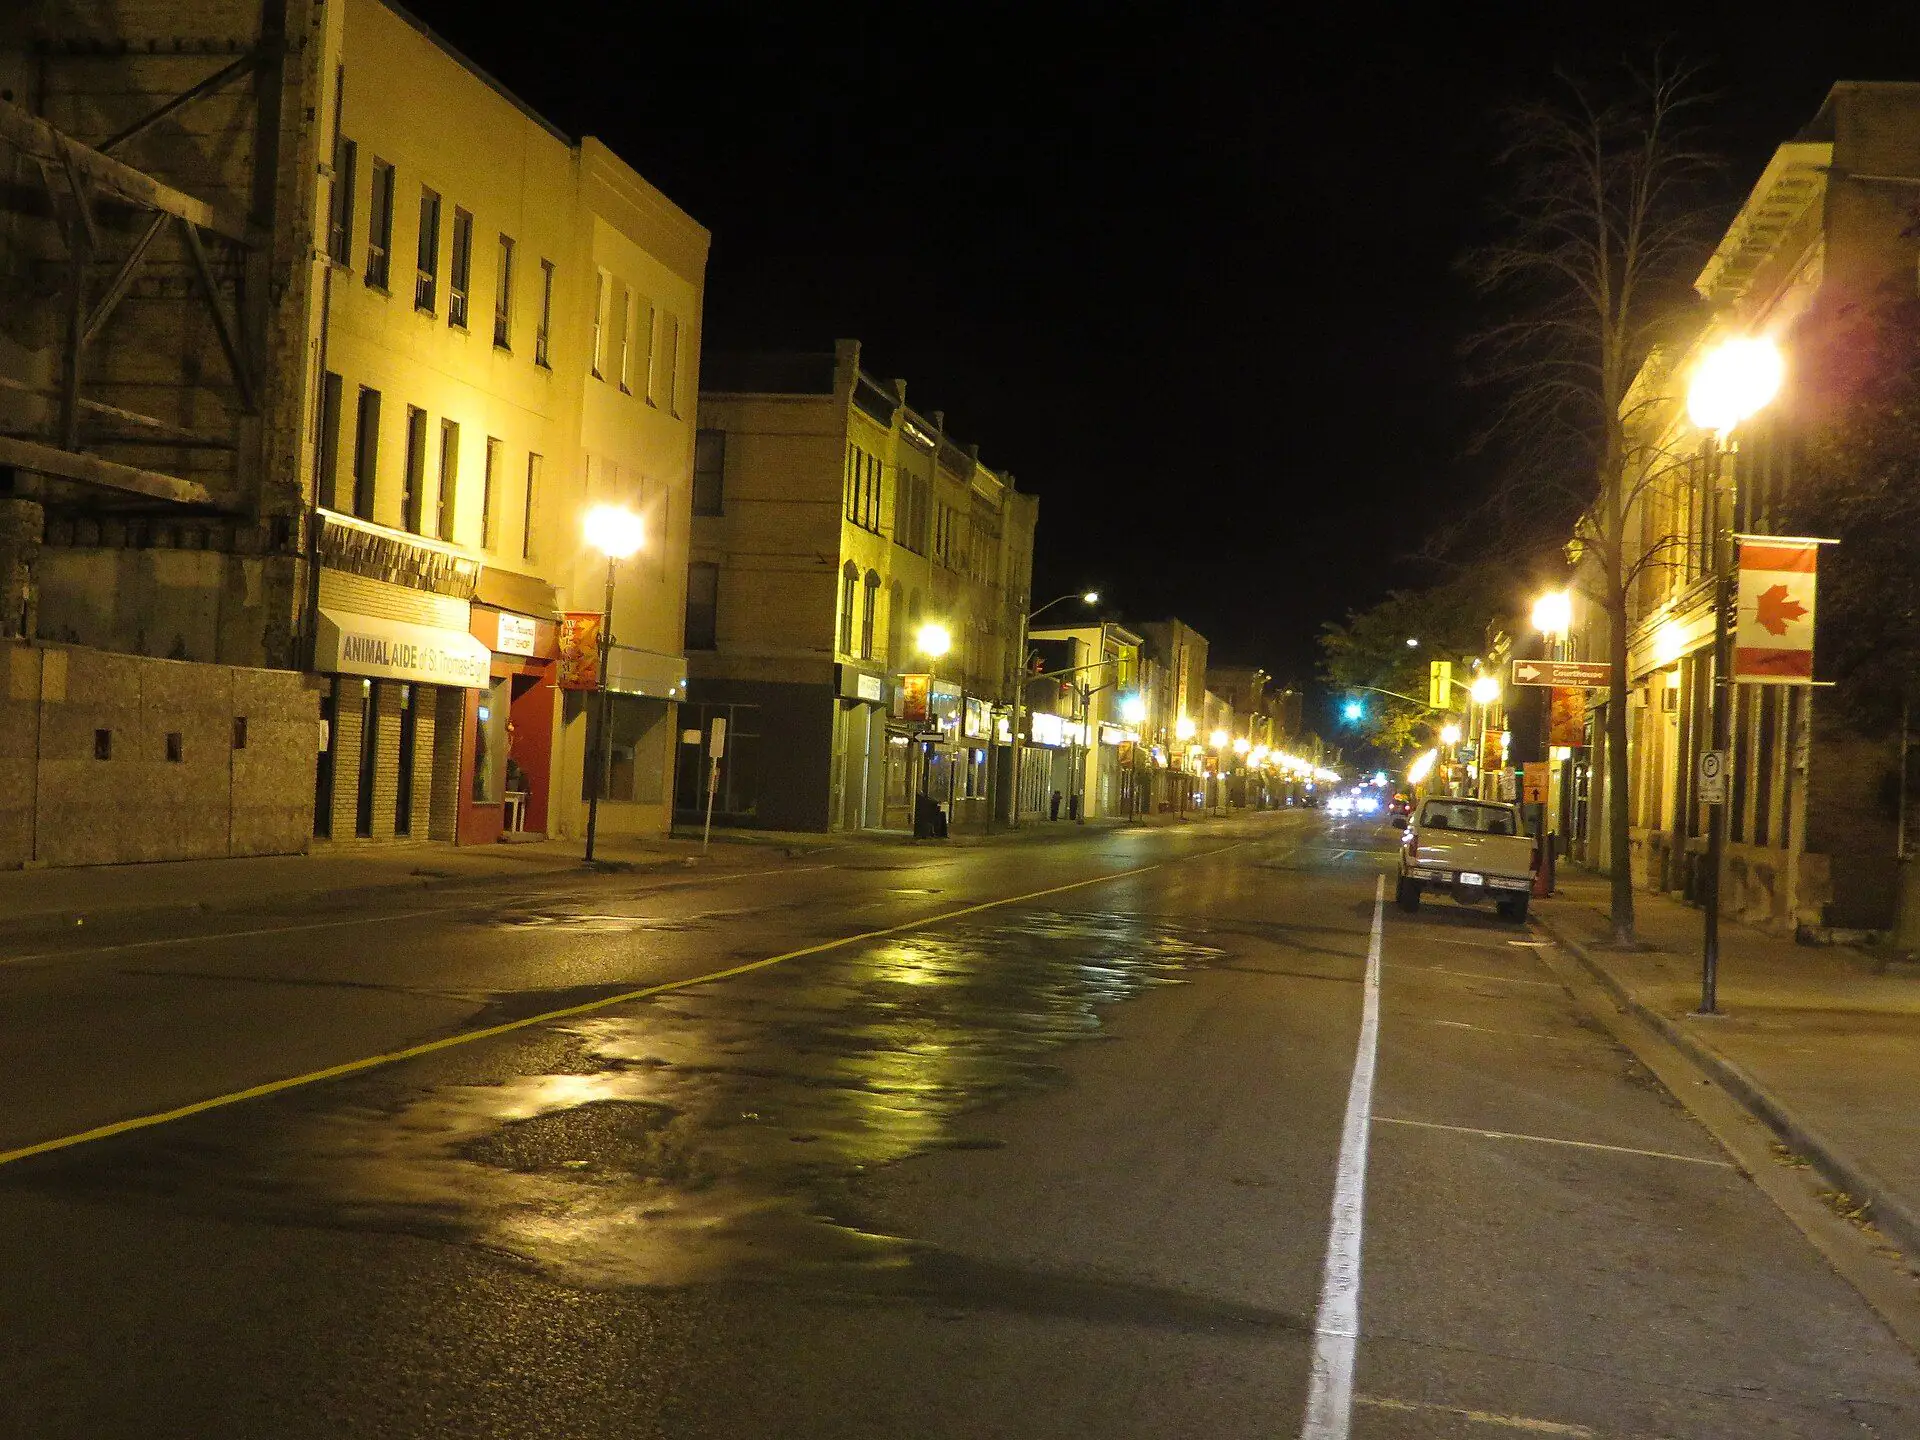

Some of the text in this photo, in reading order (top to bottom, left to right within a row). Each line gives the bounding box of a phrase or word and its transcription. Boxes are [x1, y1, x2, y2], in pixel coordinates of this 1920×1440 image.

[343, 635, 389, 665] ANIMAL
[391, 643, 418, 669] AIDE
[439, 650, 488, 684] Thomas-Egin
[1552, 669, 1604, 679] Courthouse
